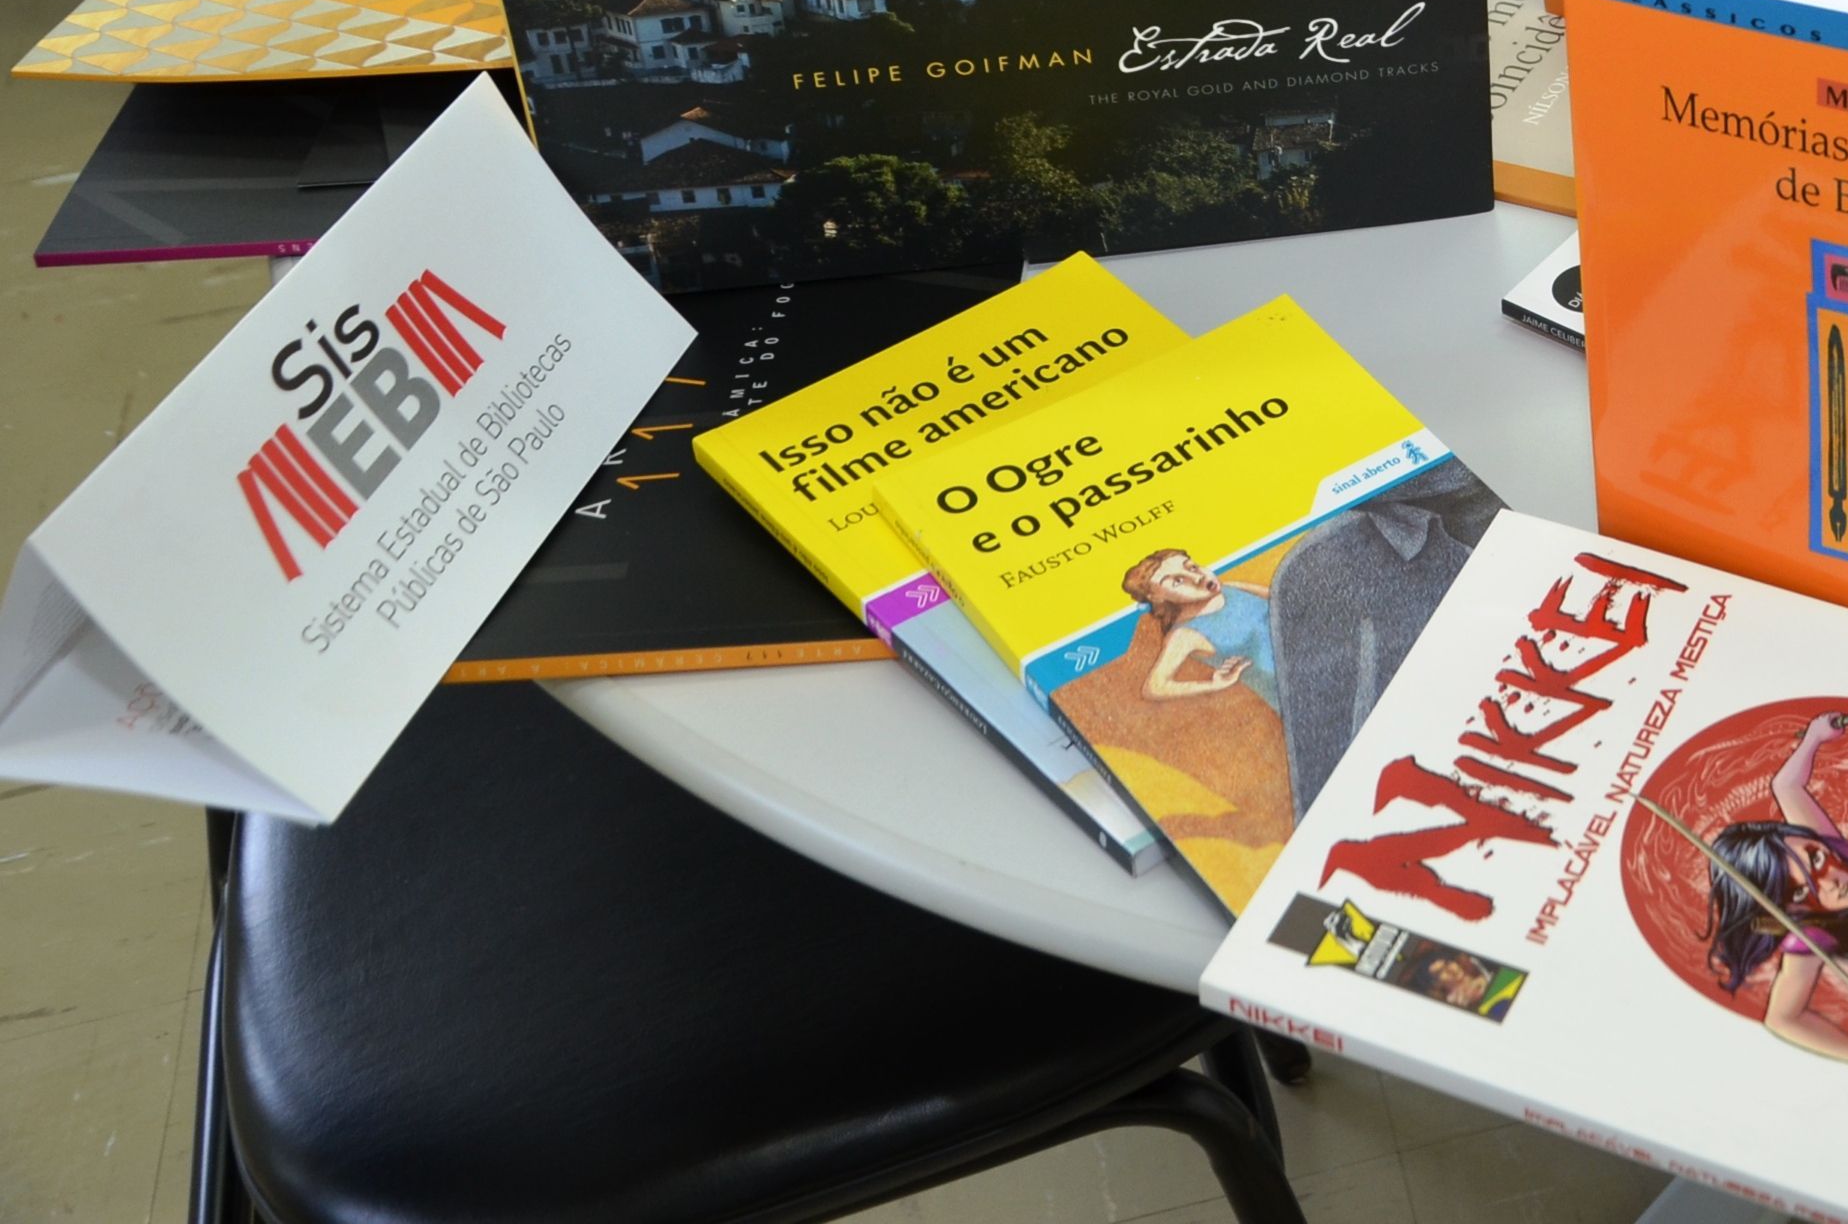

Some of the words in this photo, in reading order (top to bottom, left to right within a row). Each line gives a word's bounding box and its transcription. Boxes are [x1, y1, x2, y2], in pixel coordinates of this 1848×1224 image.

[793, 64, 902, 90] FELIPE
[927, 47, 1094, 78] GOIFMAN
[1118, 20, 1290, 74] Estrada
[1300, 1, 1425, 63] Real
[1089, 91, 1118, 106] THE
[1127, 85, 1178, 102] ROYAL
[1186, 81, 1235, 98] GOLD
[1243, 78, 1280, 91] AND
[1286, 69, 1371, 89] DIAMOND
[1378, 61, 1440, 79] TRACKS
[1775, 168, 1821, 209] de
[271, 303, 380, 420] Sis
[1522, 314, 1549, 332] JAIME
[306, 347, 441, 502] EB
[758, 422, 854, 473] Isso
[860, 385, 940, 427] não
[946, 356, 976, 385] é
[979, 321, 1050, 368] um
[791, 436, 912, 502] filme
[917, 326, 1130, 444] americano
[302, 555, 391, 655] Sistema
[377, 459, 466, 562] Estadual
[459, 435, 489, 469] de
[475, 332, 573, 441] Bibliotecas
[376, 533, 466, 629] Públicas
[458, 503, 488, 535] de
[475, 461, 520, 508] São
[508, 400, 567, 465] Paulo
[936, 486, 979, 515] O
[985, 429, 1103, 487] Ogre
[970, 529, 1003, 554] e
[1011, 514, 1042, 539] o
[1050, 396, 1290, 529] passarinho
[1332, 474, 1361, 495] sinal
[1360, 455, 1401, 481] aberto
[999, 542, 1093, 591] FAUSTO
[1093, 500, 1178, 544] WOLFF
[1317, 551, 1689, 924] NIKKEI
[1526, 808, 1617, 946] IMPLACÁVEL
[1606, 688, 1682, 803] NATUREZA
[1670, 593, 1733, 681] MESTIÇA
[1228, 997, 1345, 1054] NIKKEI
